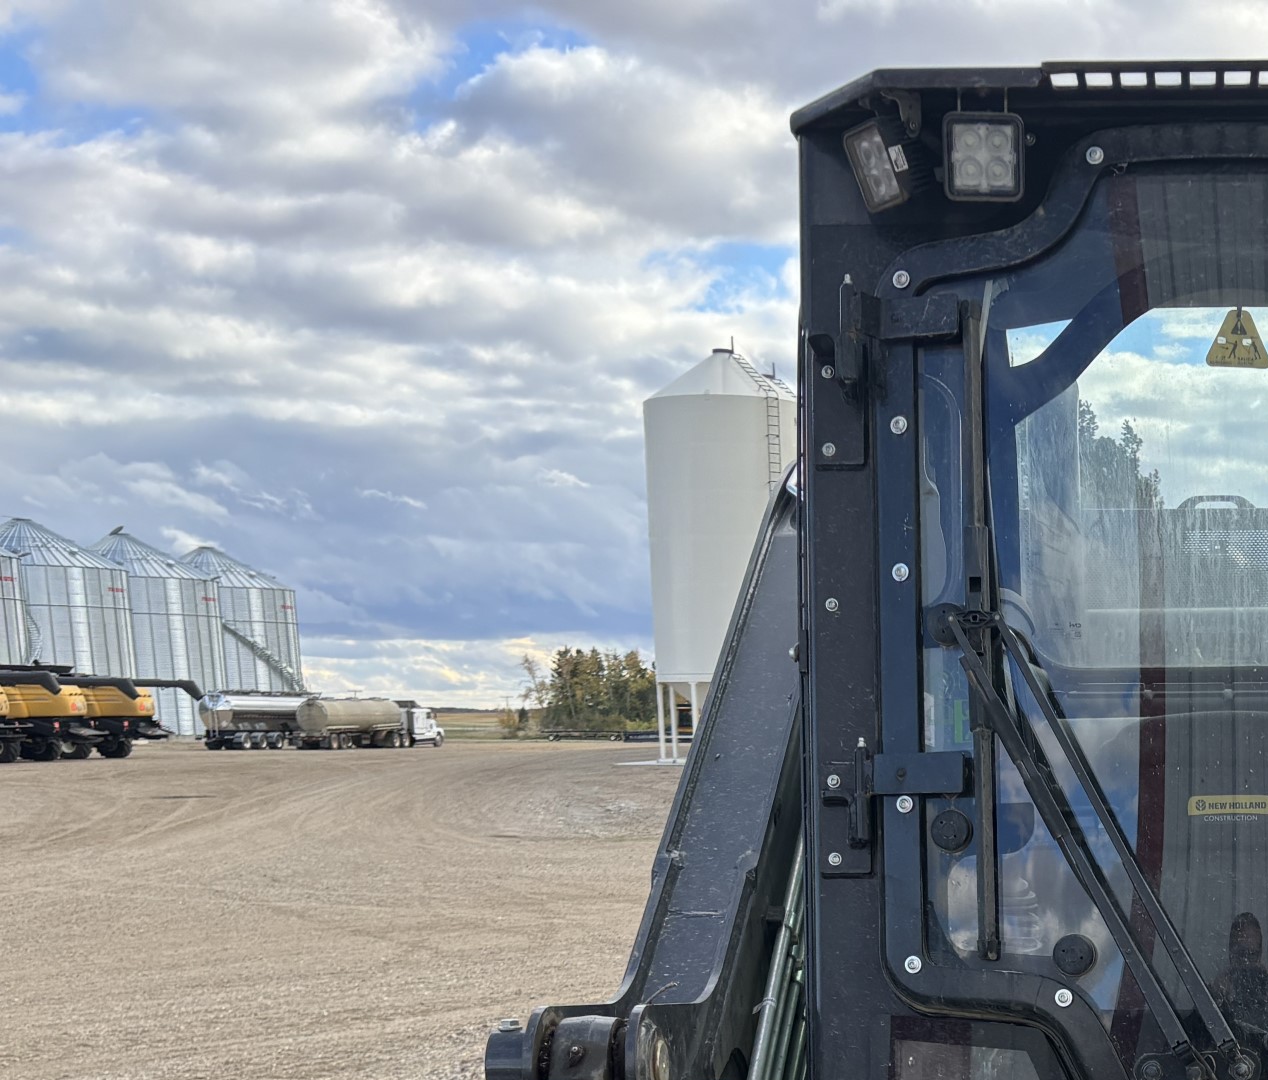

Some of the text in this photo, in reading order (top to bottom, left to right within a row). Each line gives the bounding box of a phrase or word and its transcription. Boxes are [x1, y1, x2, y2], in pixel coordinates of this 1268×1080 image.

[1208, 801, 1267, 810] NEW HOLLAND
[1203, 814, 1258, 822] CONSTRUCTION
